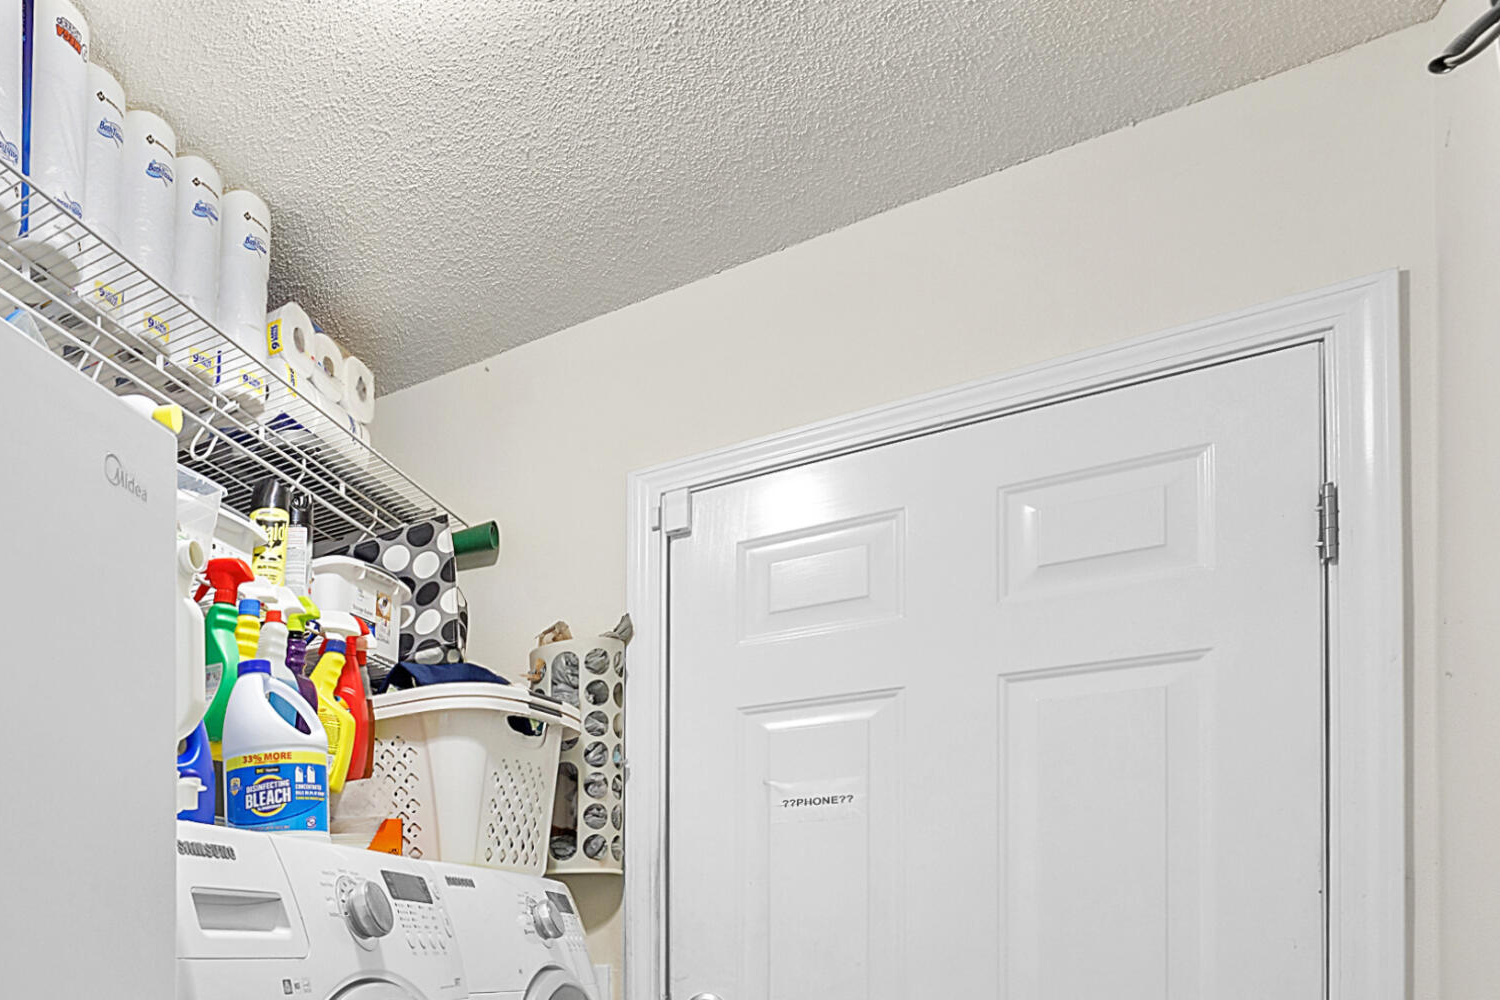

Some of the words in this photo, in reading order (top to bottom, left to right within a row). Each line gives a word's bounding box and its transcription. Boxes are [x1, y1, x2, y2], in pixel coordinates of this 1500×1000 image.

[243, 754, 262, 764] 33%
[264, 752, 292, 761] MORE
[245, 787, 292, 810] BLEACH
[782, 794, 854, 808] ??PHONE??
[177, 840, 236, 861] SAMSUNG
